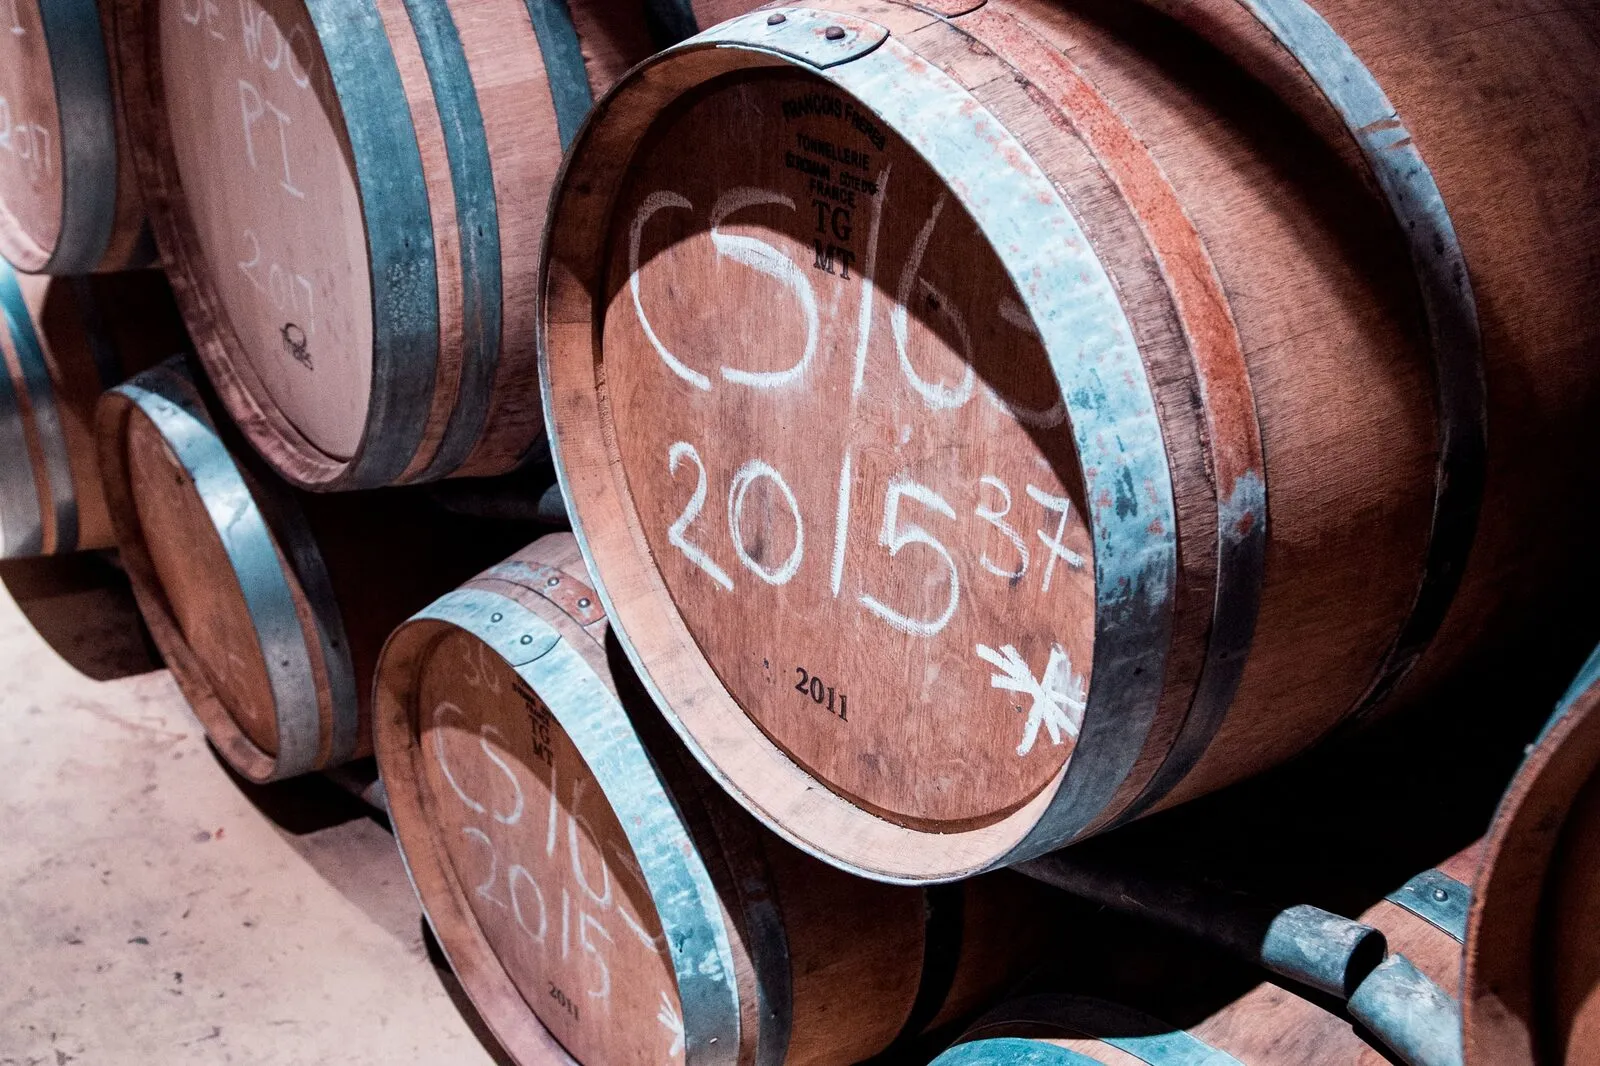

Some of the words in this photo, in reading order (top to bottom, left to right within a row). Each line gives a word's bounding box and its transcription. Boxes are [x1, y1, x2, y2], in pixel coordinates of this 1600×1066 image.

[812, 199, 852, 241] TG
[813, 238, 856, 281] MT
[667, 441, 960, 637] 2015
[975, 476, 1084, 593] 37
[794, 667, 850, 723] 2011
[547, 980, 580, 1021] 2011
